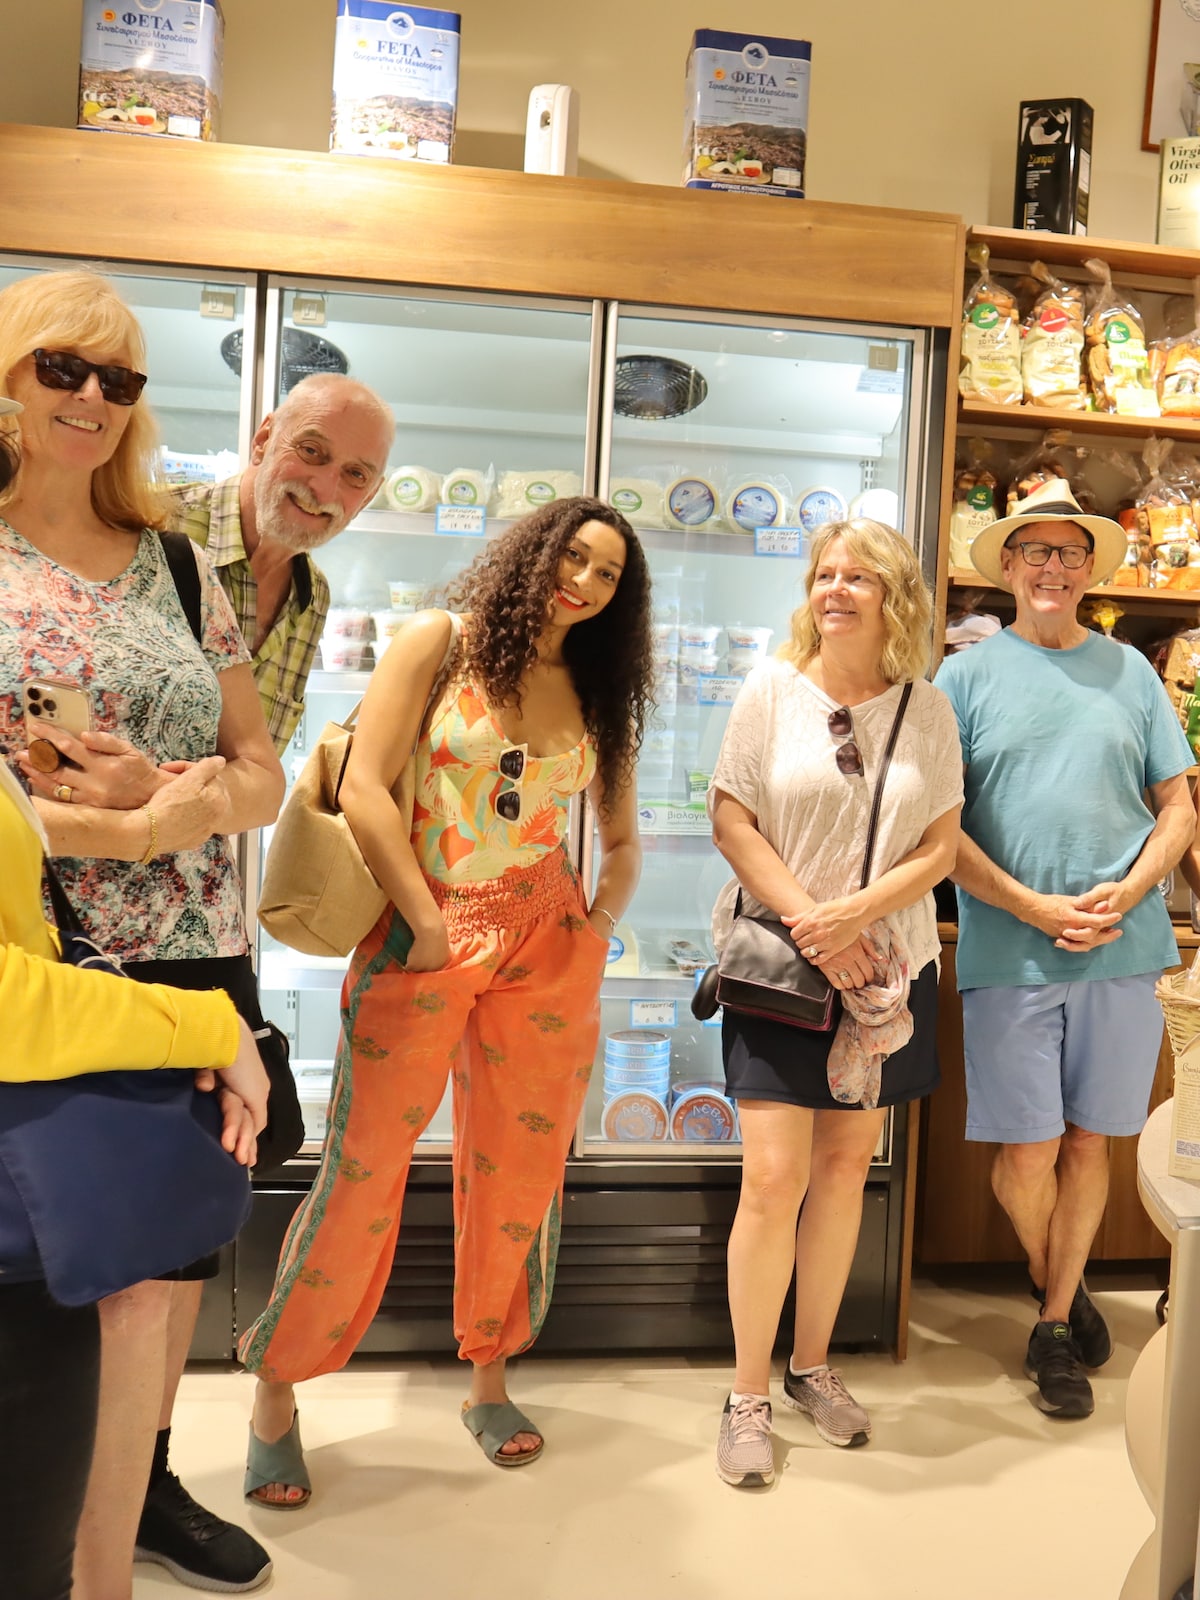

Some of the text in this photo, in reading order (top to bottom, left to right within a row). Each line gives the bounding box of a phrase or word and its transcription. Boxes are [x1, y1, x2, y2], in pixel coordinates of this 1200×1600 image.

[122, 12, 174, 32] ΦΕΤΑ
[376, 40, 422, 58] FETA
[730, 70, 778, 88] ΦΕΤΑ
[1168, 172, 1188, 184] Oil
